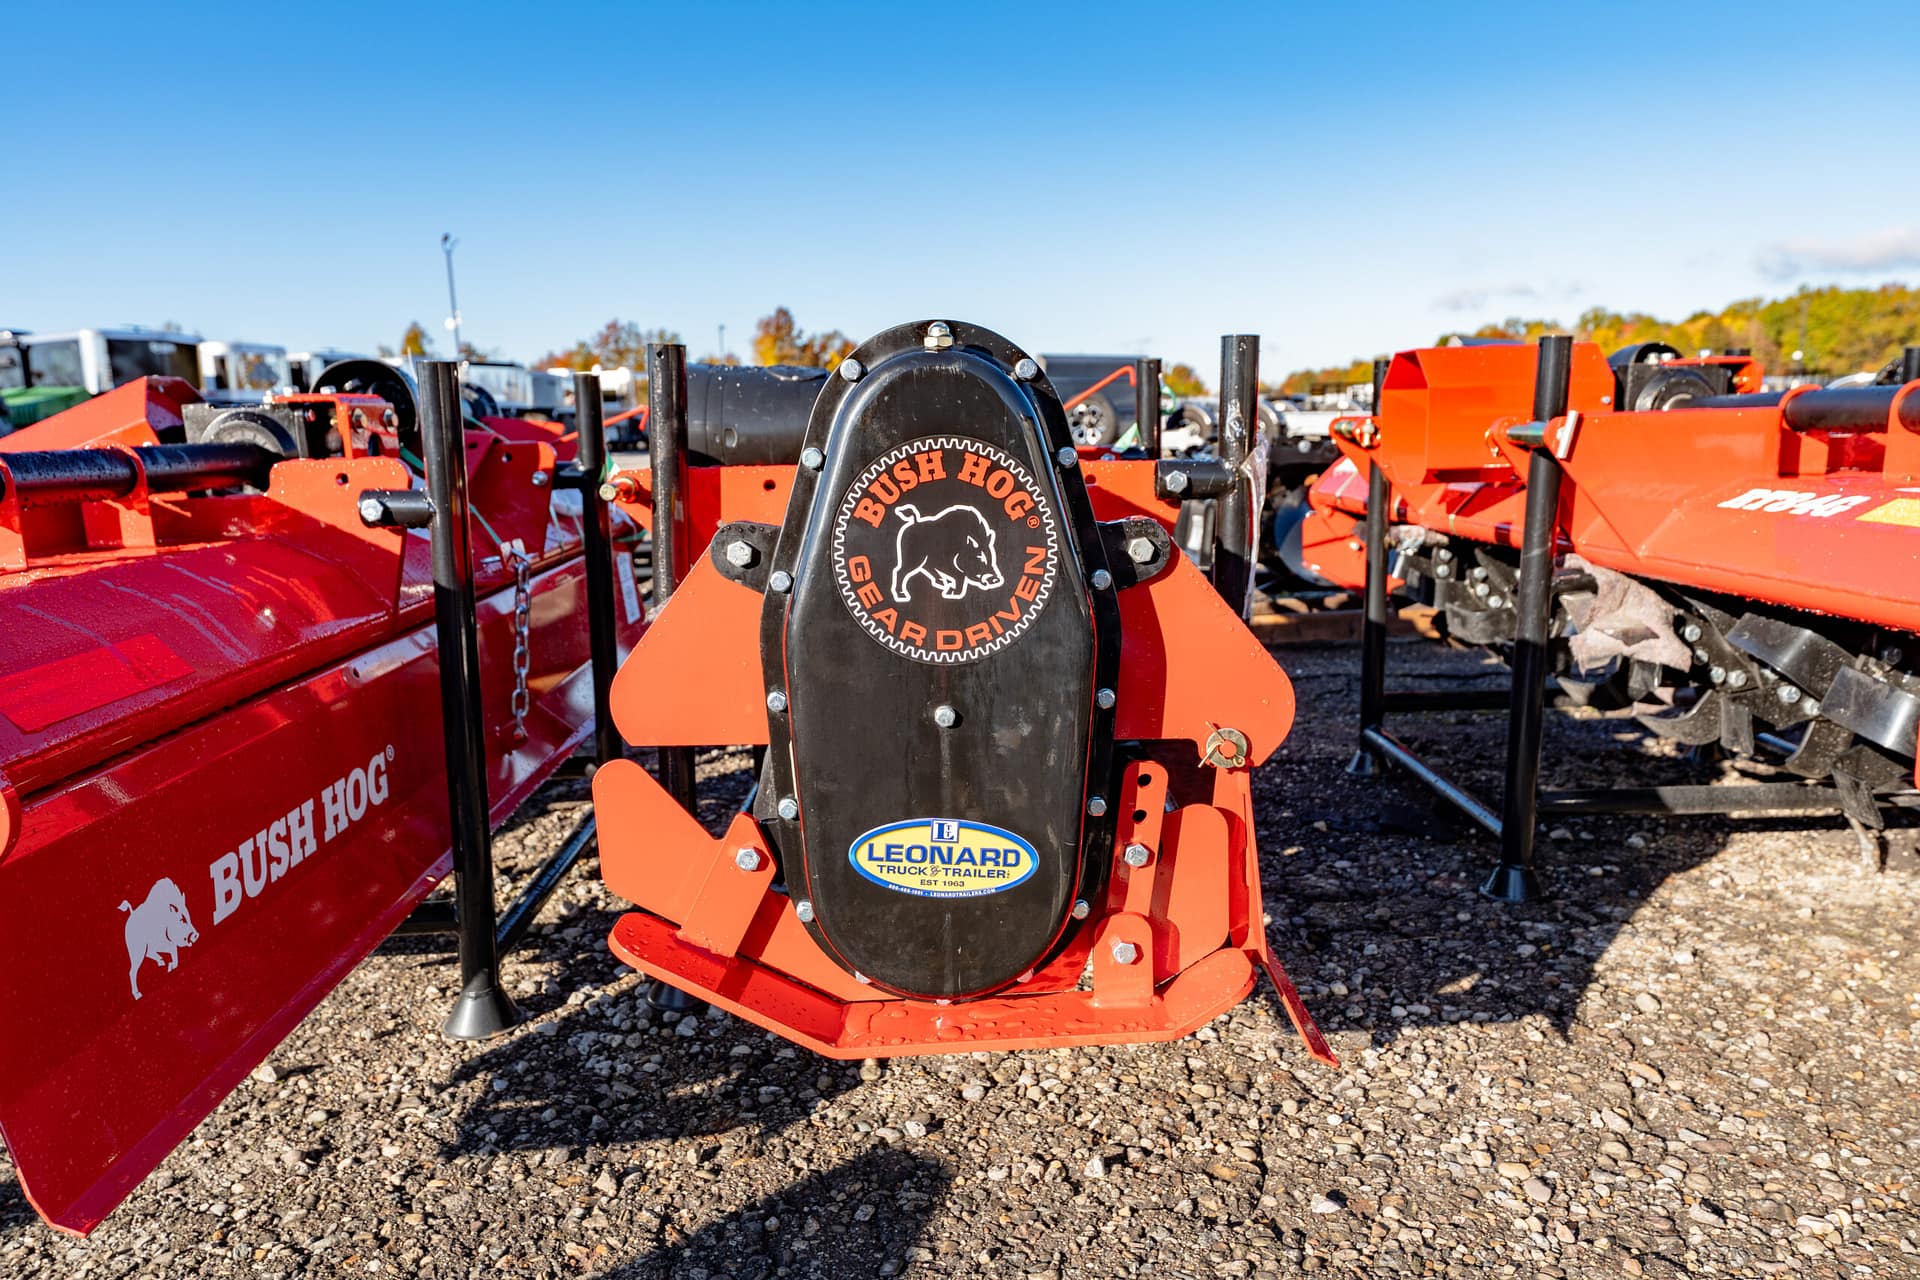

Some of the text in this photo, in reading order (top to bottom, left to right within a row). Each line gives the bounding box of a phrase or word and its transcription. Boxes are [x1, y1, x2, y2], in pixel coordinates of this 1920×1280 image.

[853, 450, 947, 529] BUSH
[848, 546, 1047, 650] GEAR DRIVEN
[209, 798, 317, 927] BUSH
[867, 843, 1021, 868] LEONARD
[877, 864, 928, 877] TRUCK
[940, 867, 1006, 879] TRAILER
[920, 879, 965, 888] EST 1963
